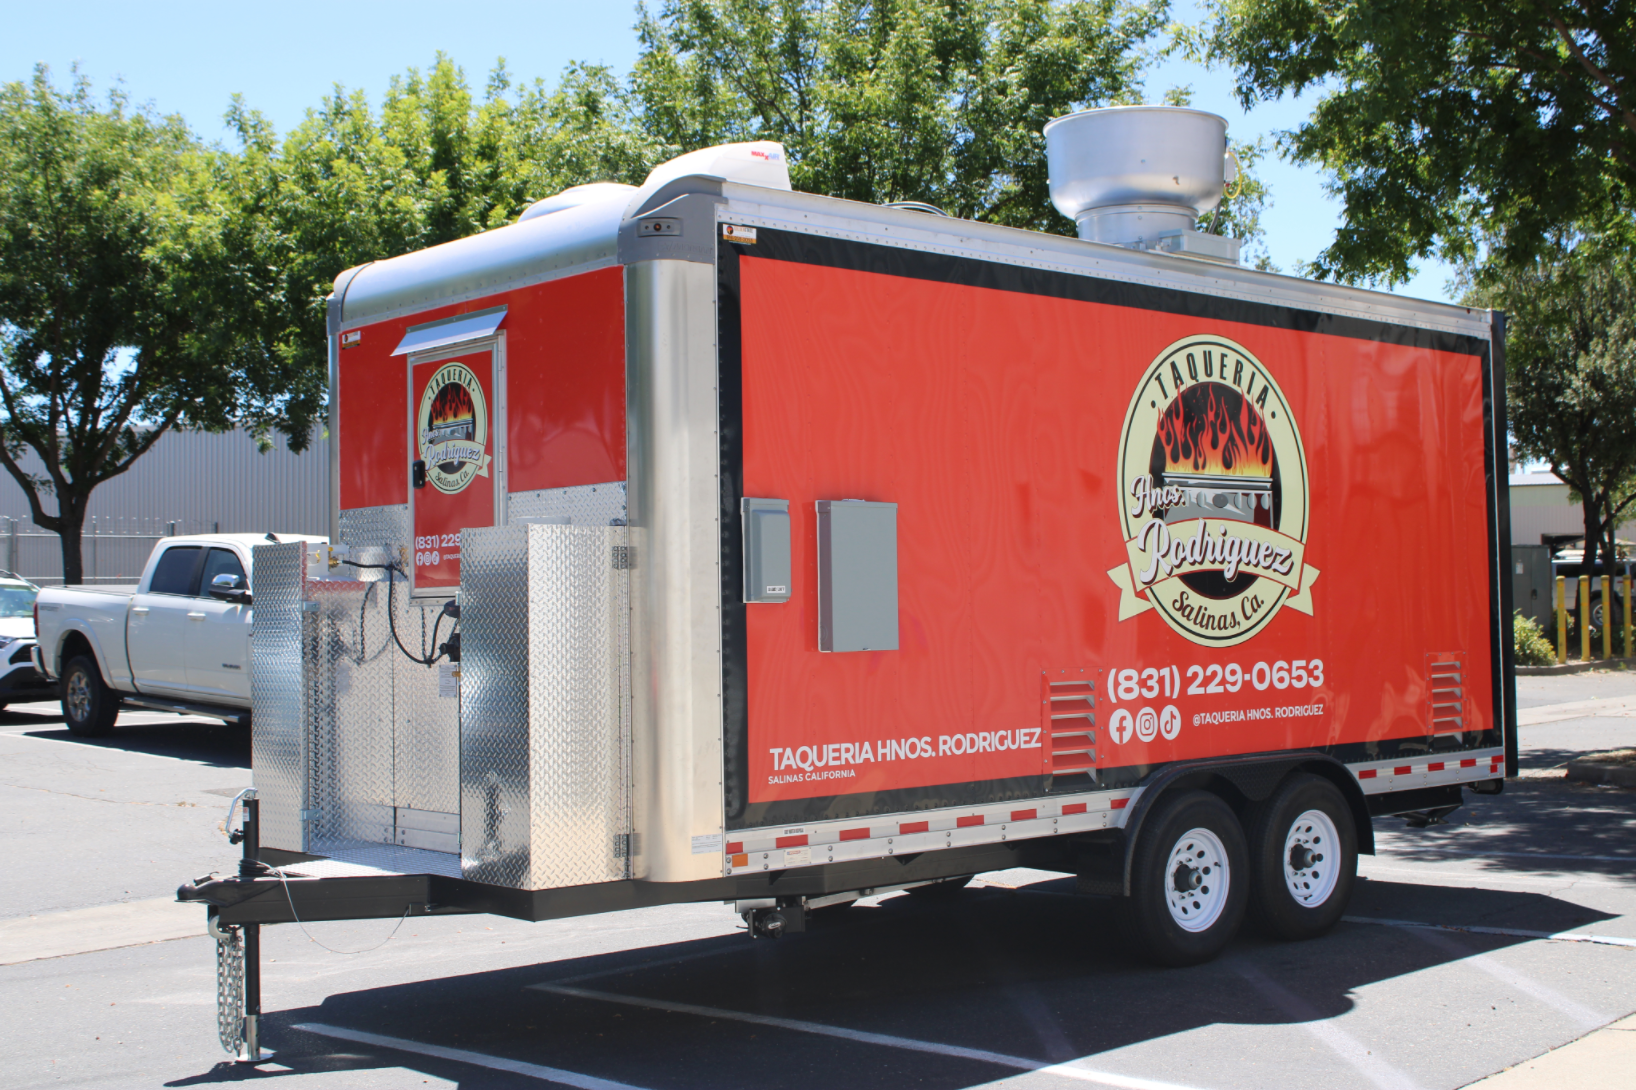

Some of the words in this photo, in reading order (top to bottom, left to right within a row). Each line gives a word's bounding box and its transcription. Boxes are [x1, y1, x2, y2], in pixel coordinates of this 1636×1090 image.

[429, 368, 473, 395] TAQUERIA
[1154, 350, 1270, 413] TAQUERIA
[424, 442, 481, 471] Rodriguez
[1130, 474, 1187, 518] Hnos.
[415, 534, 440, 550] (831)
[1137, 517, 1294, 585] Rodriguez
[1172, 590, 1241, 631] Salinas,
[1240, 592, 1265, 620] Ca.
[1107, 665, 1181, 703] (831)
[1186, 658, 1325, 695] 229-0653
[1193, 710, 1246, 726] @TAQUERIA
[1247, 707, 1273, 721] HNOS.
[1275, 703, 1324, 718] RODRIGUEZ
[769, 741, 875, 771] TAQUERIA
[877, 736, 936, 762] HNOS.
[938, 727, 1042, 757] RODRIGUEZ
[768, 773, 804, 785] SALINAS
[804, 768, 856, 782] CALIFORNIA
